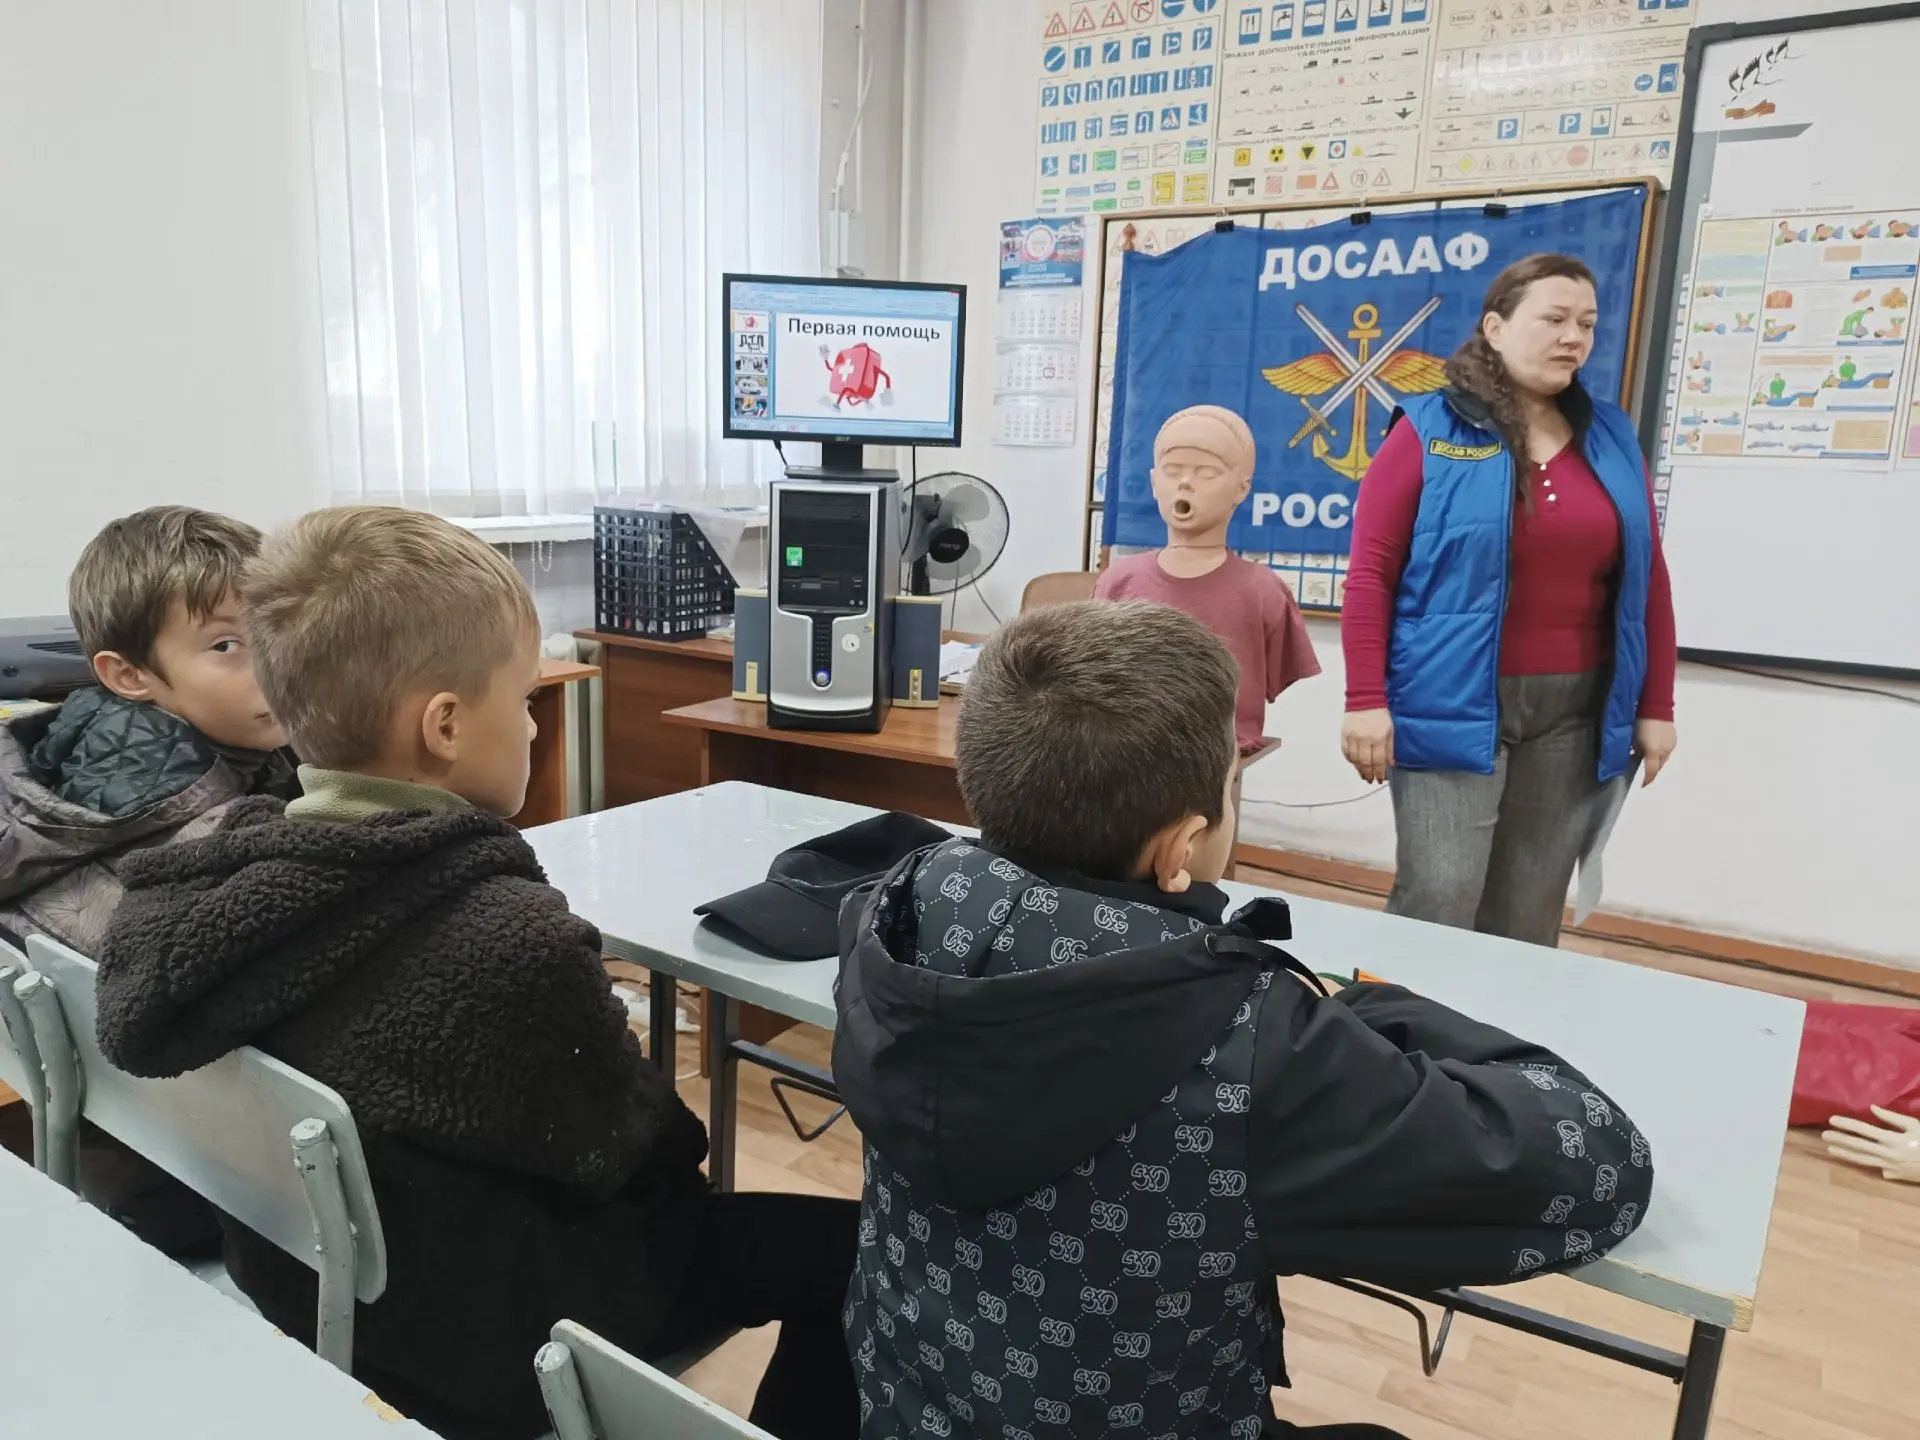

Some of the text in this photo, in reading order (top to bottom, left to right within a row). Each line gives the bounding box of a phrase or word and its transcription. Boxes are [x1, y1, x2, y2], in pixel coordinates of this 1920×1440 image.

[1258, 232, 1489, 291] ДОСААФ
[788, 317, 940, 342] Первая помощь
[1252, 493, 1357, 529] РОС
